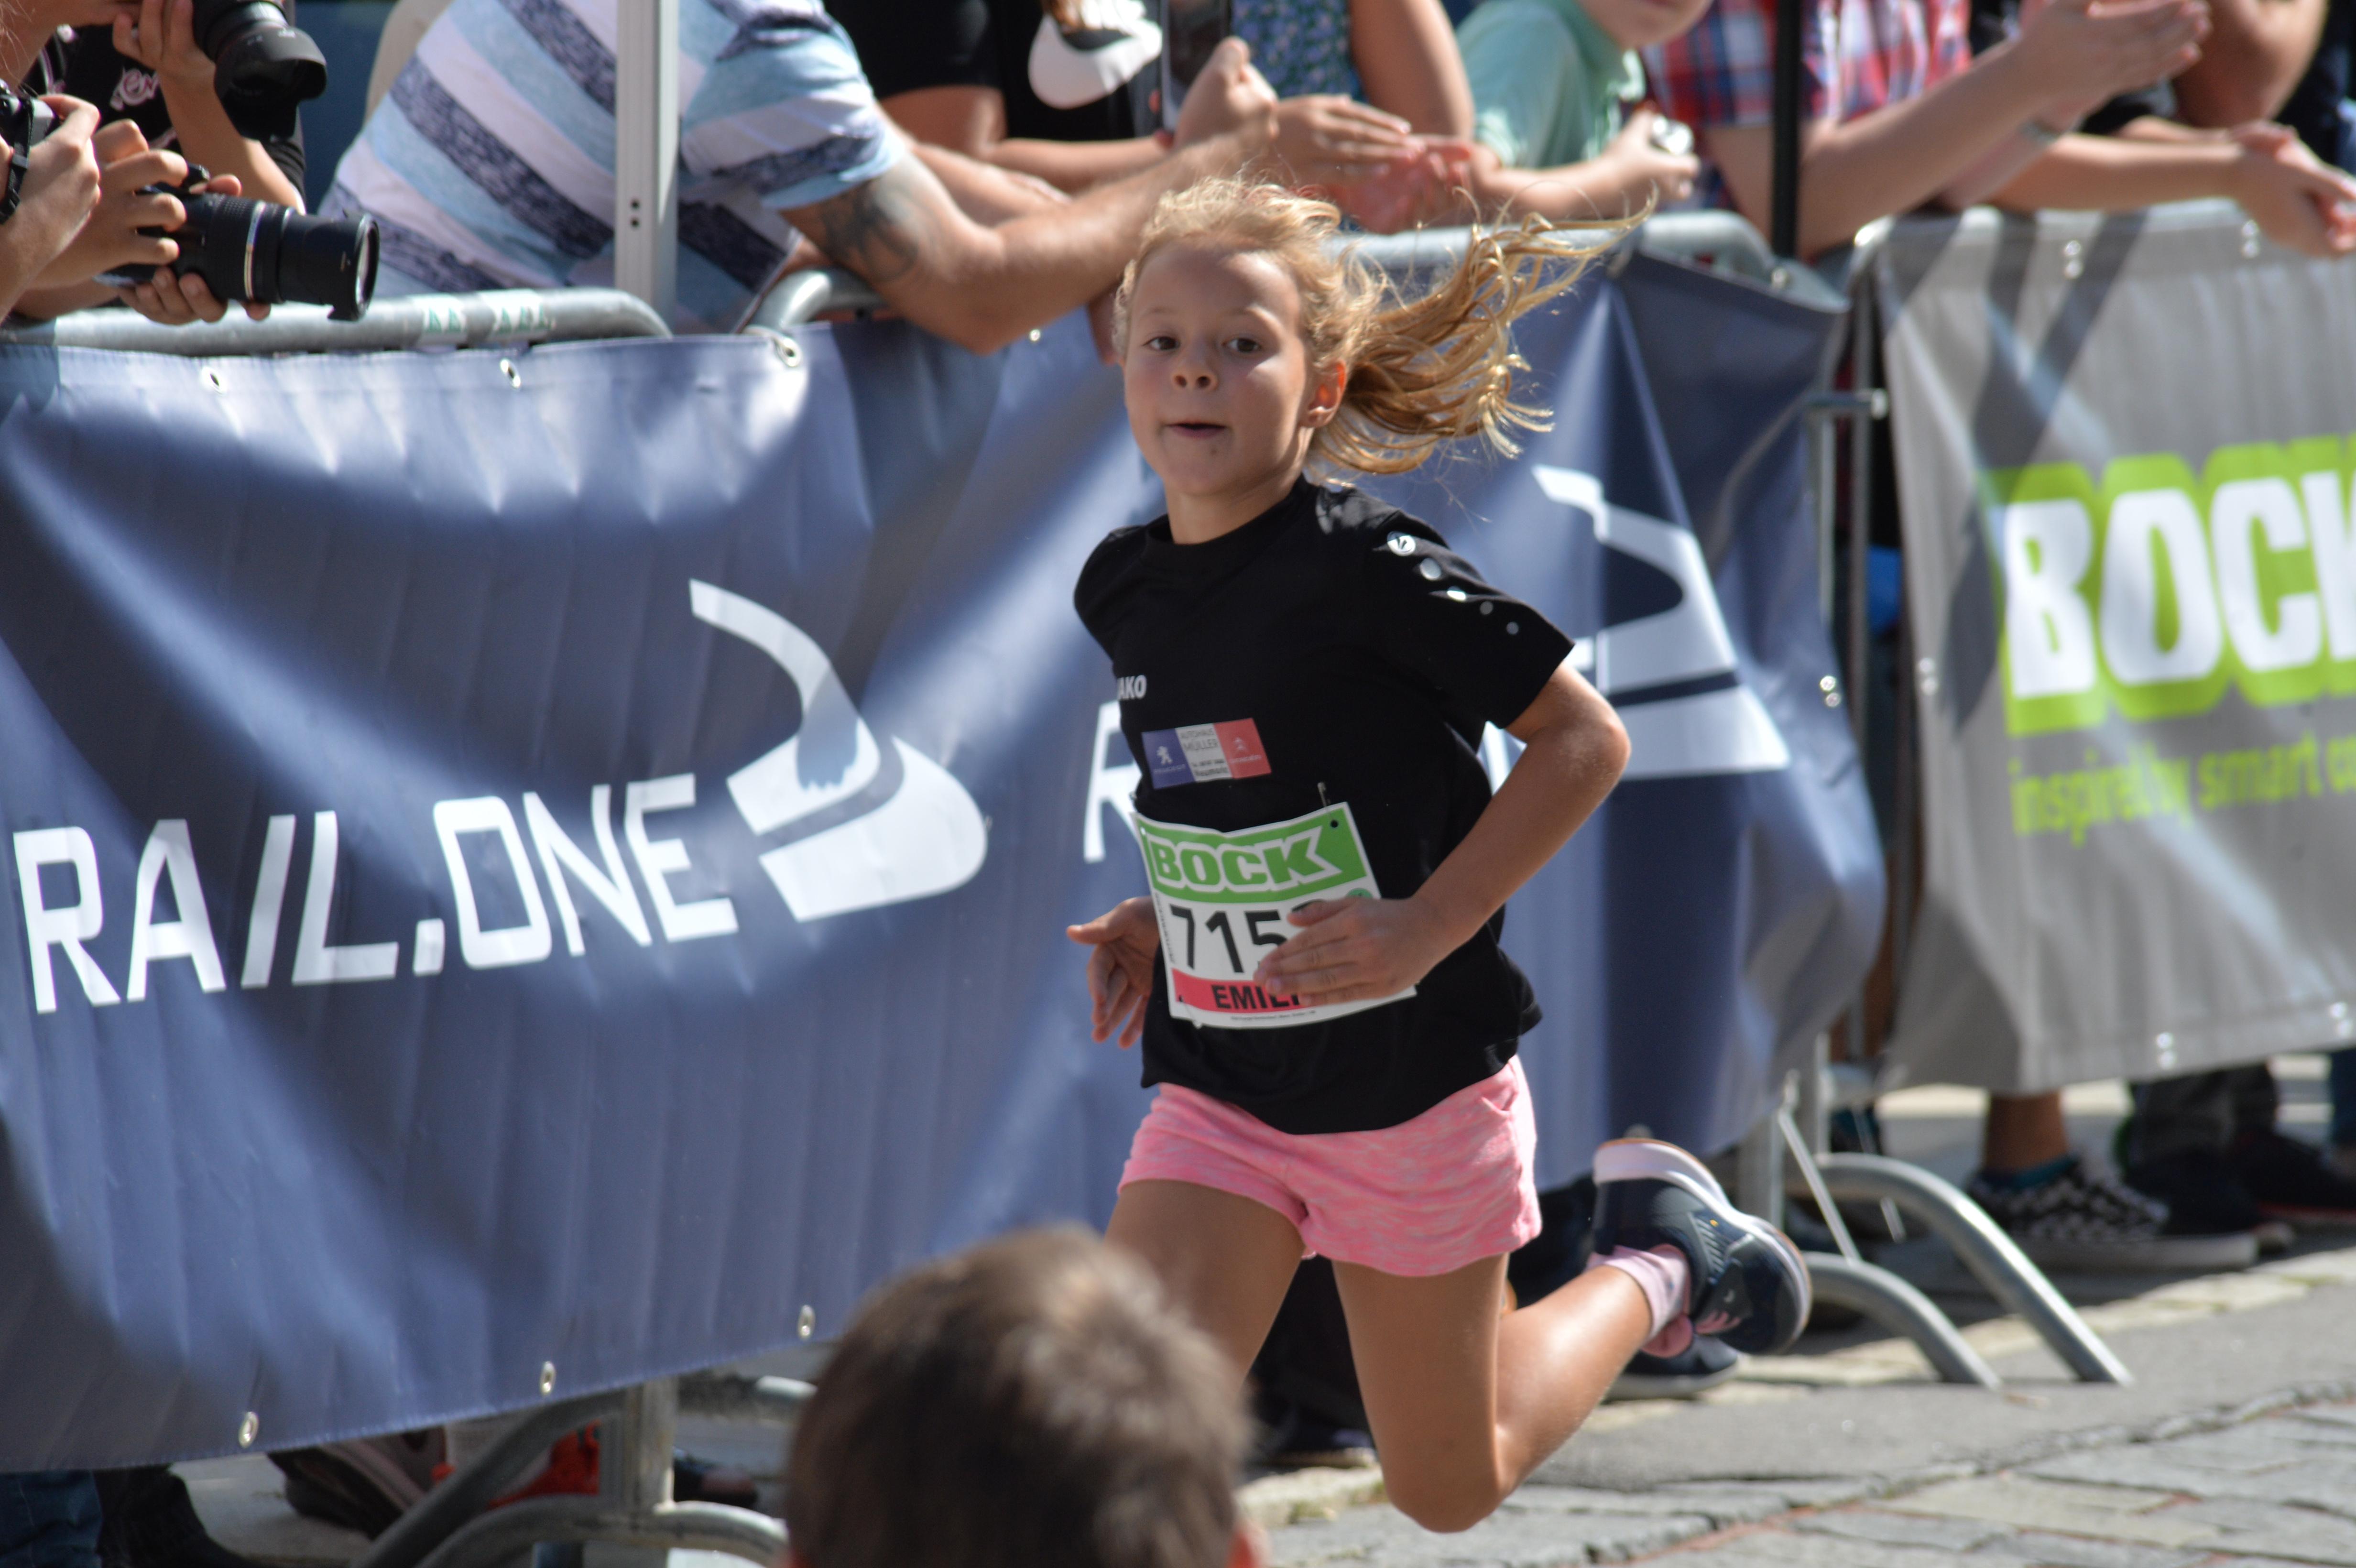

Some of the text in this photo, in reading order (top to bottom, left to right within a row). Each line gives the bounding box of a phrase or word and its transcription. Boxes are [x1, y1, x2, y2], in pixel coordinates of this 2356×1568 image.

[1182, 738, 1220, 752] MÜLLER
[2198, 729, 2323, 813] smart
[12, 772, 739, 1014] RAIL.ONE
[1149, 836, 1327, 887] BOCK
[1169, 899, 1326, 973] 715
